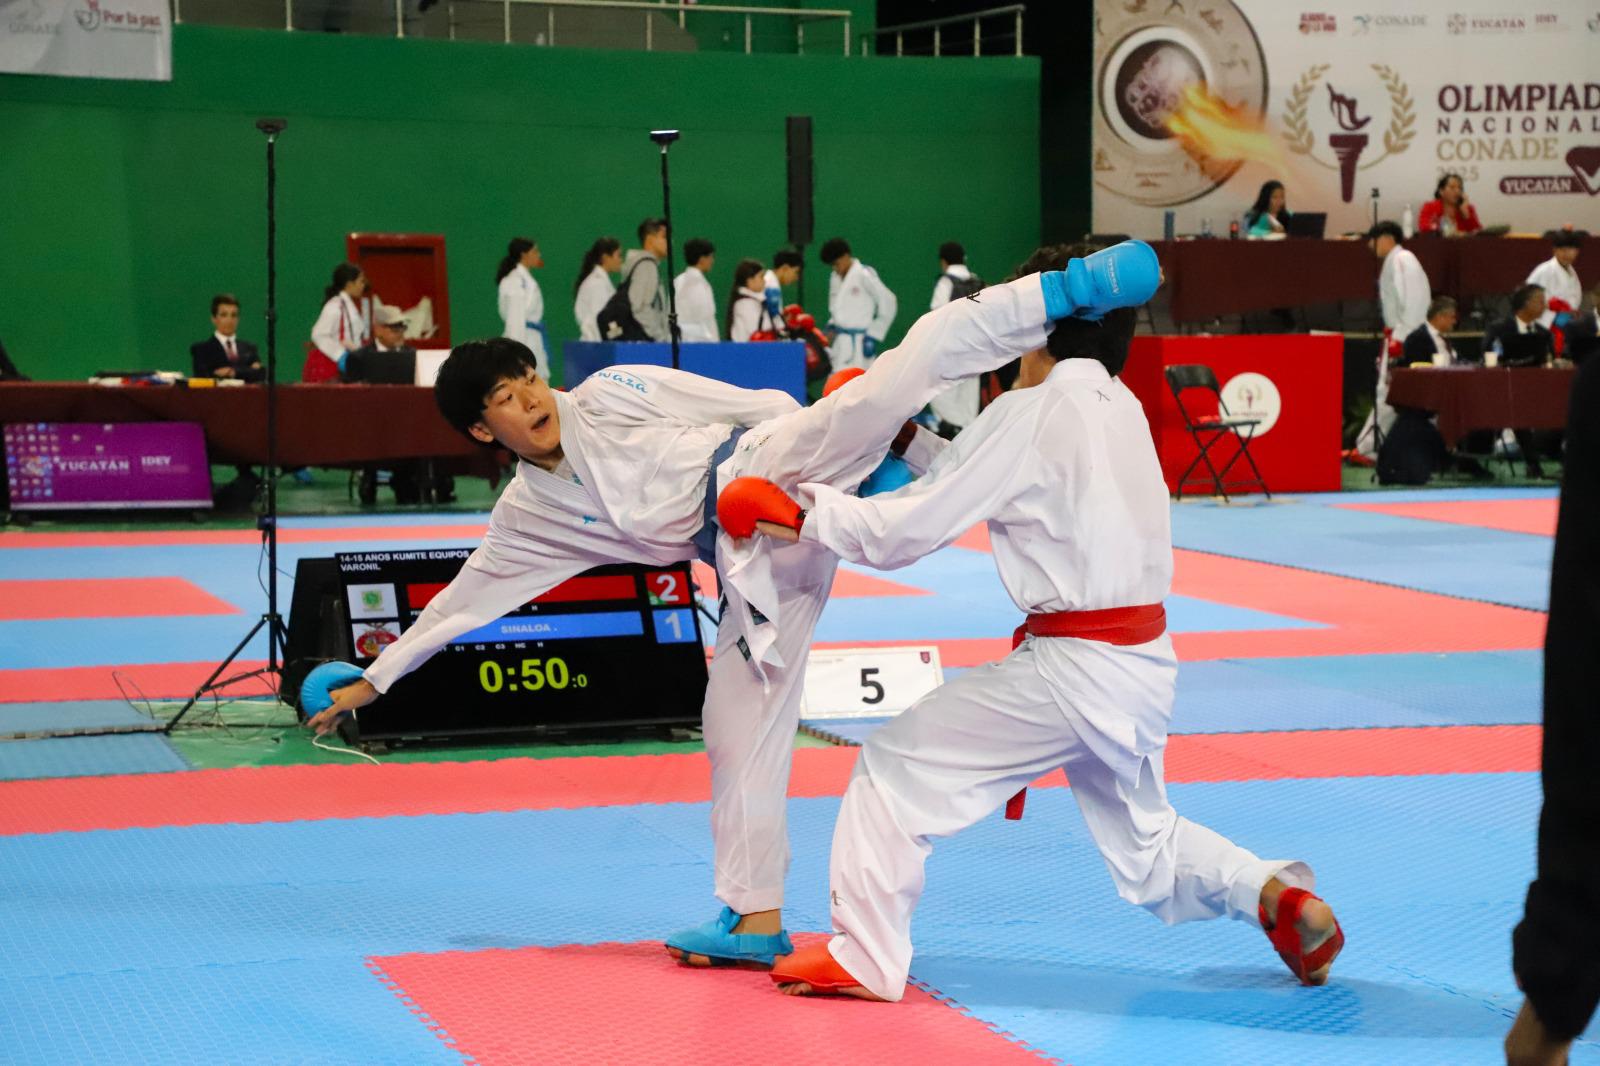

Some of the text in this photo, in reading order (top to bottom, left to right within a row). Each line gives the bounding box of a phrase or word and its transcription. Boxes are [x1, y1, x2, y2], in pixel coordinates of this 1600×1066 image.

[1436, 137, 1559, 161] CONADE
[141, 455, 172, 466] IDEY
[340, 554, 364, 563] 14-15
[392, 552, 427, 561] KUMITE
[429, 549, 470, 560] EQUIPOS
[341, 562, 382, 572] VARONIL
[656, 574, 680, 602] 2
[501, 623, 552, 635] SINALOA
[664, 612, 683, 641] 1
[479, 657, 569, 693] 0:50
[861, 667, 885, 705] 5
